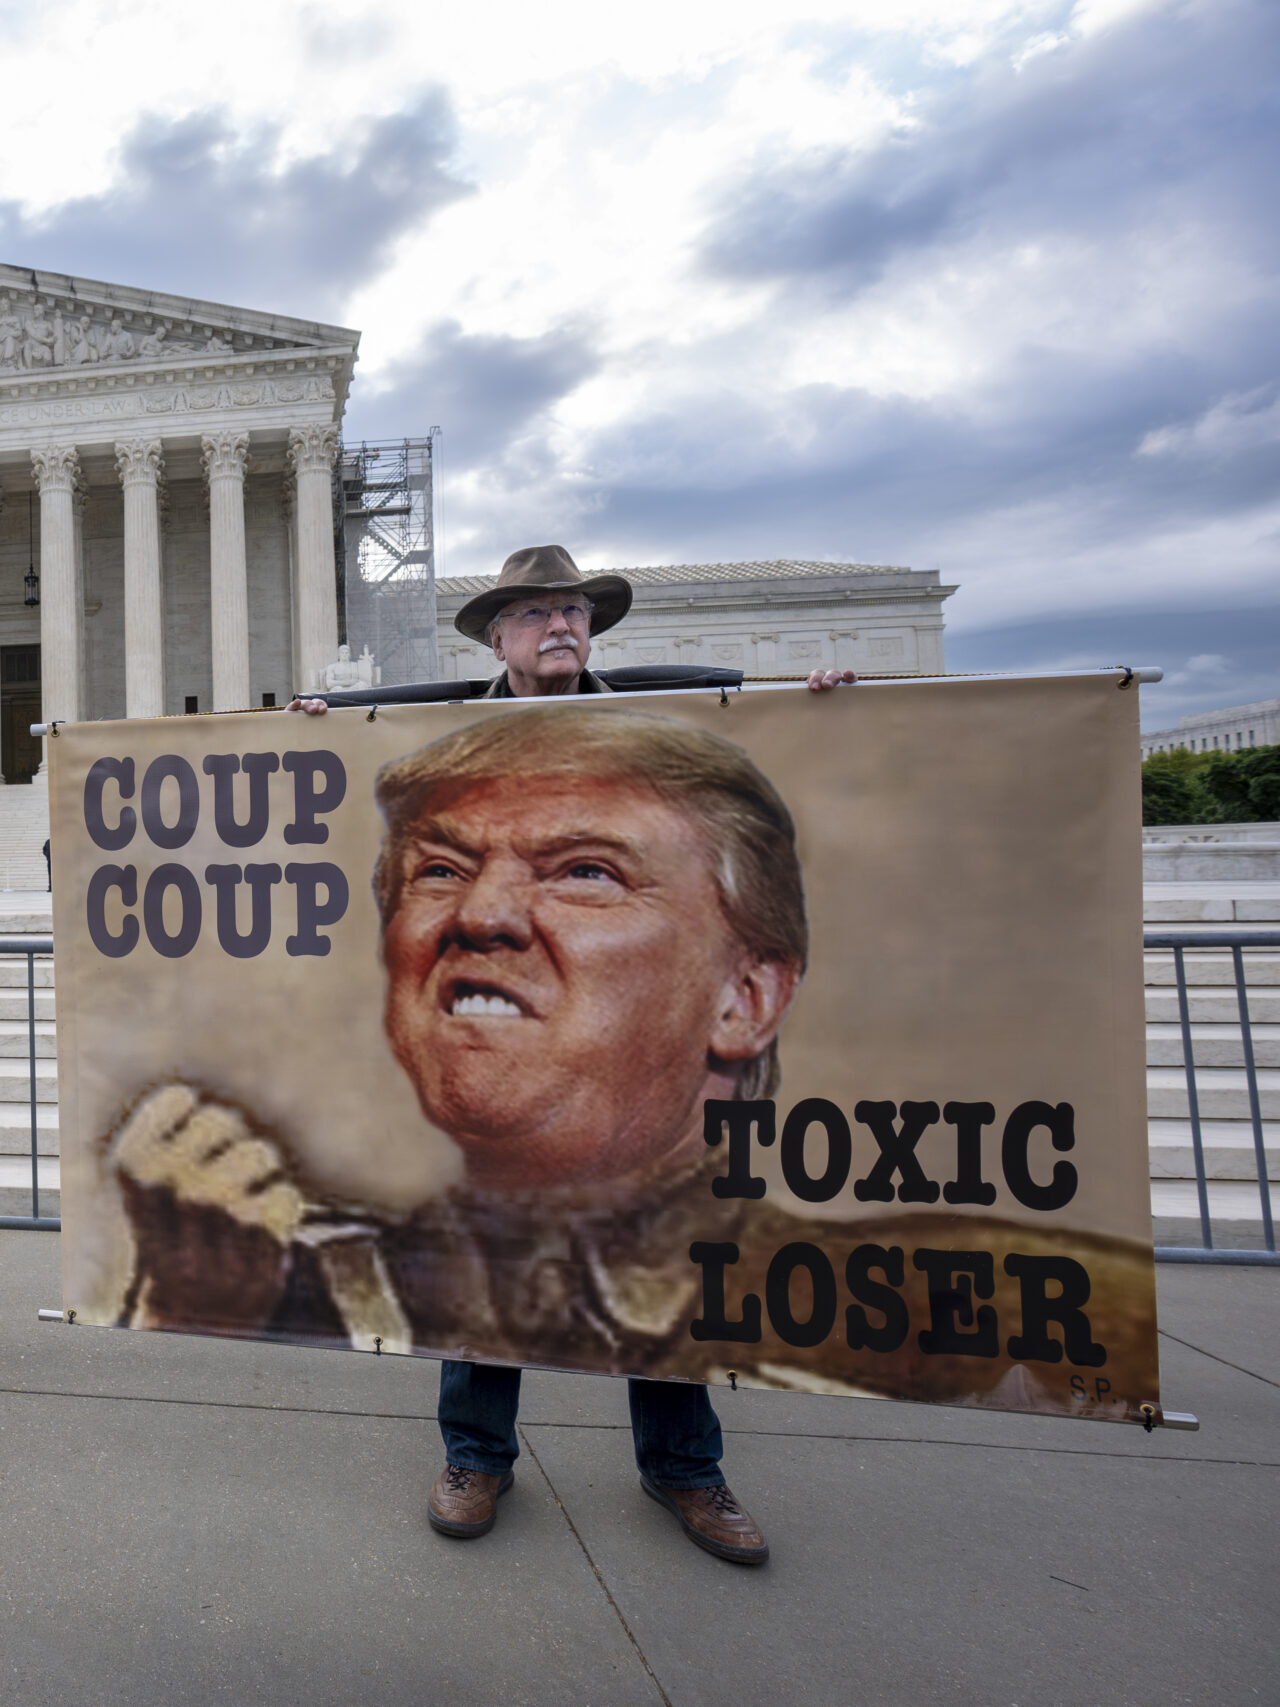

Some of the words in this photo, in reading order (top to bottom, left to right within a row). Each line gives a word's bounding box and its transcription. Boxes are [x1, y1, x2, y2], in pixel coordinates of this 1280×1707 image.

[27, 402, 86, 421] UNDER
[92, 399, 127, 415] LAW
[84, 750, 347, 851] COUP
[87, 862, 349, 958] COUP
[704, 1098, 1078, 1211] TOXIC
[689, 1241, 1107, 1367] LOSER
